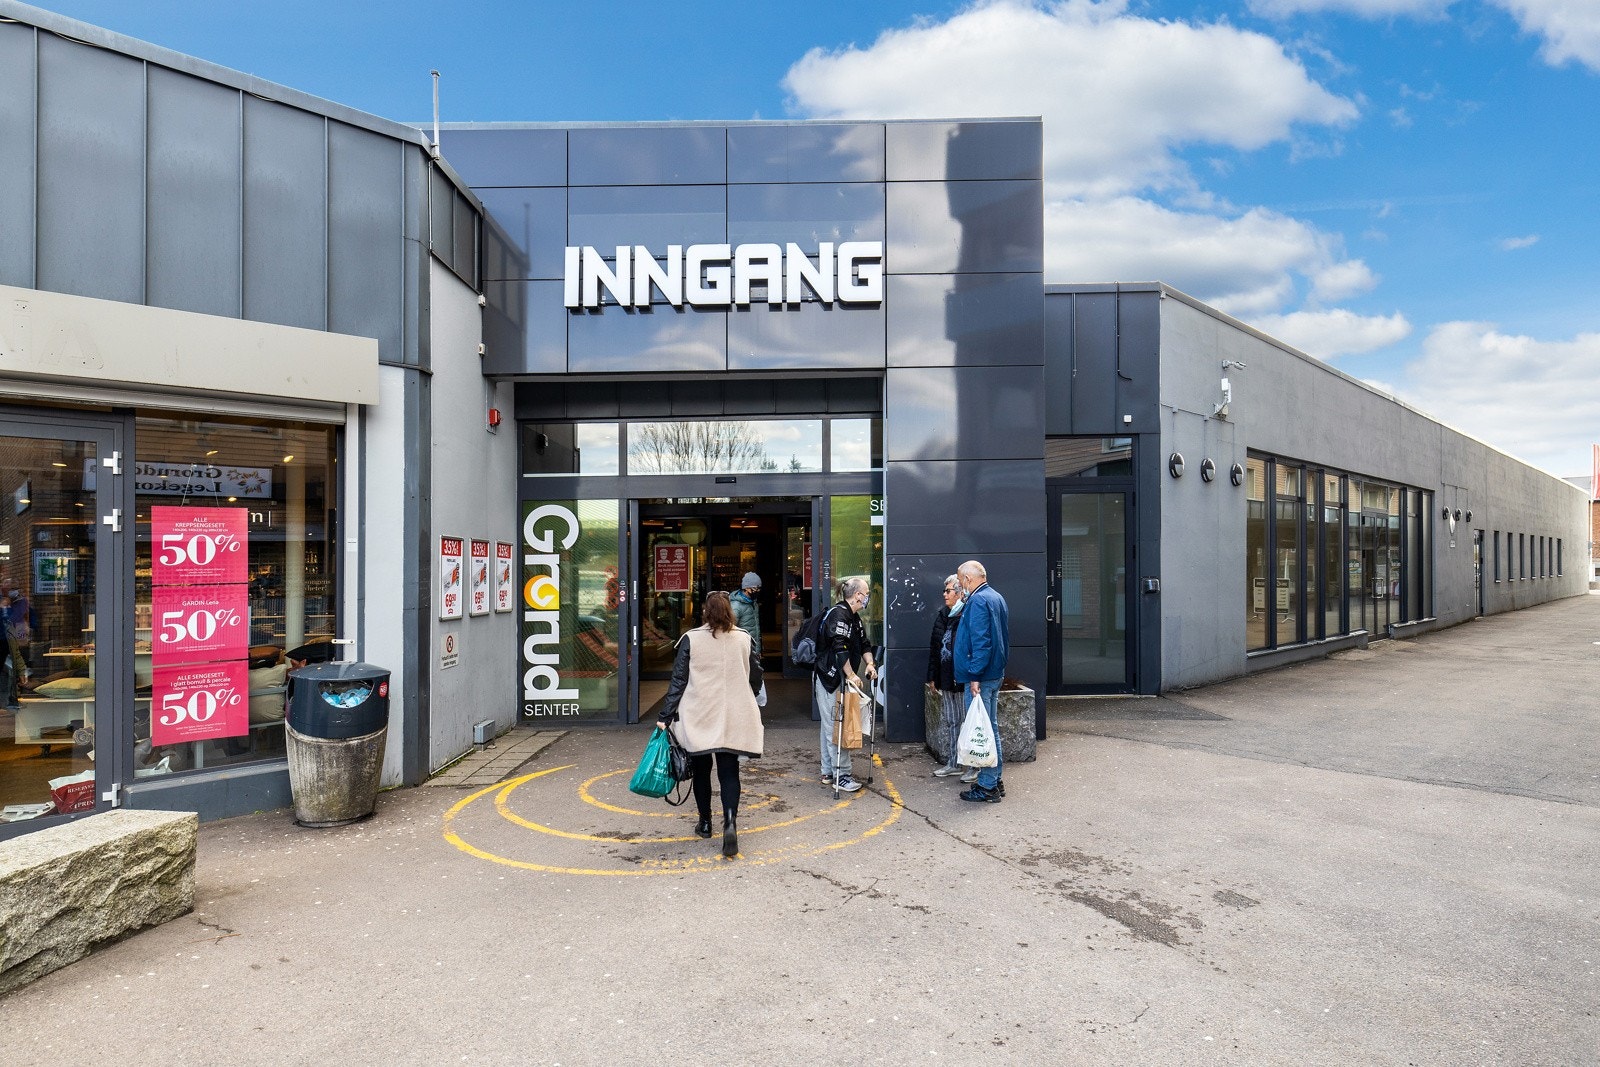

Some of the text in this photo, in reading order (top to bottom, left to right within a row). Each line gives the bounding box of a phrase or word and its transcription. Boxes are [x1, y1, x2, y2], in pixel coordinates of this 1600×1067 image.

[564, 241, 883, 307] INNGANG
[160, 533, 240, 566] 50%
[160, 608, 240, 643] 50%
[160, 687, 241, 726] 50%
[524, 703, 580, 716] SENTER
